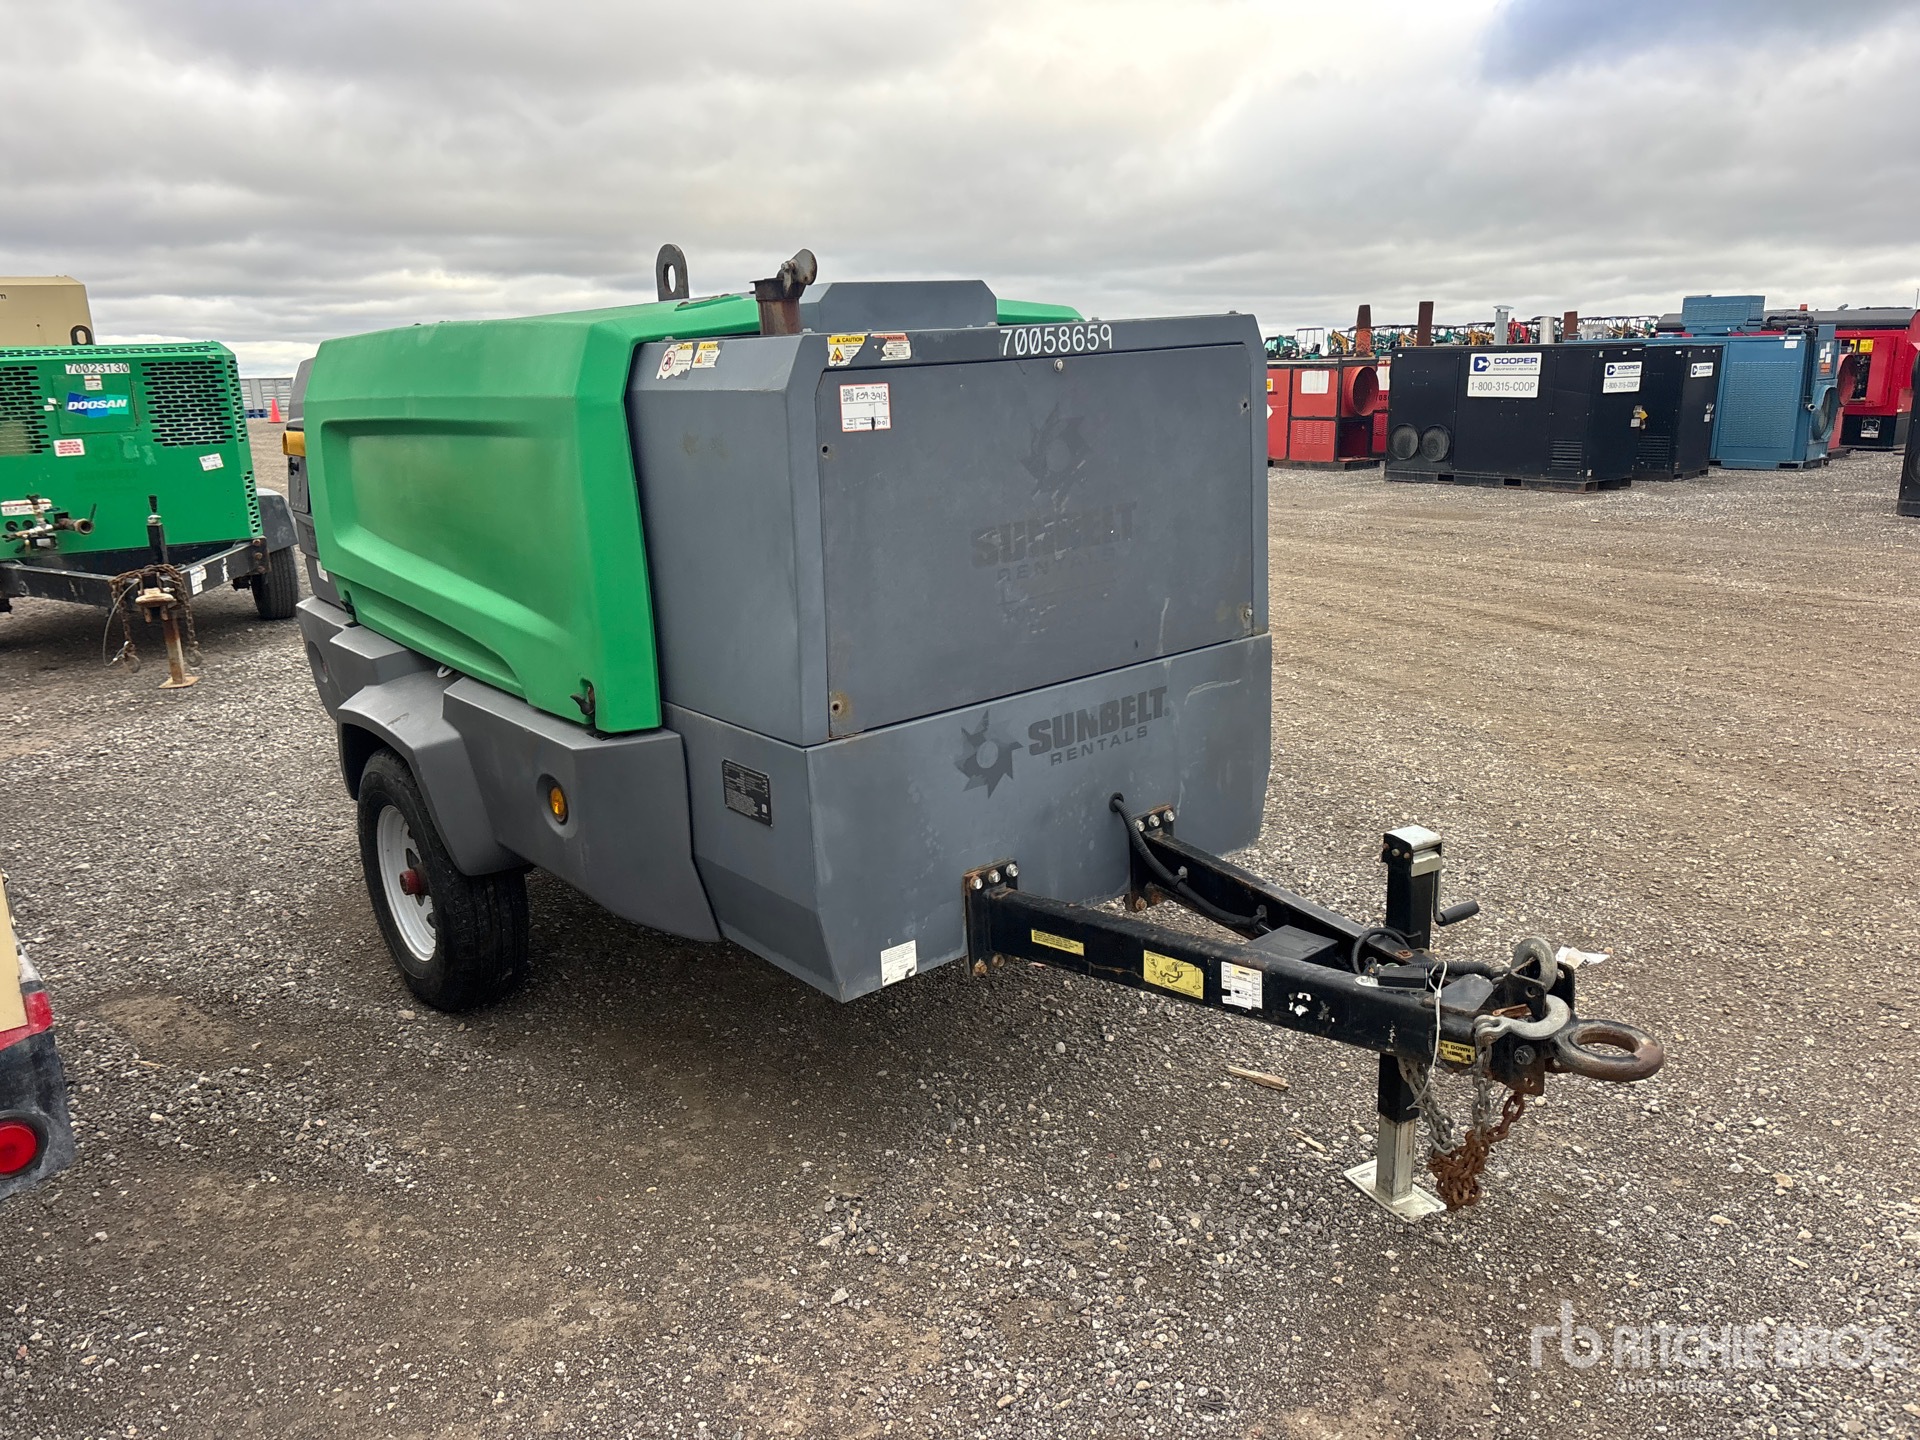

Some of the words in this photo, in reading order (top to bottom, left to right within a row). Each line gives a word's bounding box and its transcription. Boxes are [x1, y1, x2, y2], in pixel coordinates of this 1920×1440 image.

[1000, 323, 1113, 356] 70058659
[1494, 357, 1538, 365] COOPER
[67, 363, 129, 374] 70023130
[1471, 381, 1536, 392] 1-800-315-COOP
[67, 399, 128, 411] DOOSAN
[1028, 686, 1167, 756] SUNBELT
[1051, 725, 1148, 766] RENTALS
